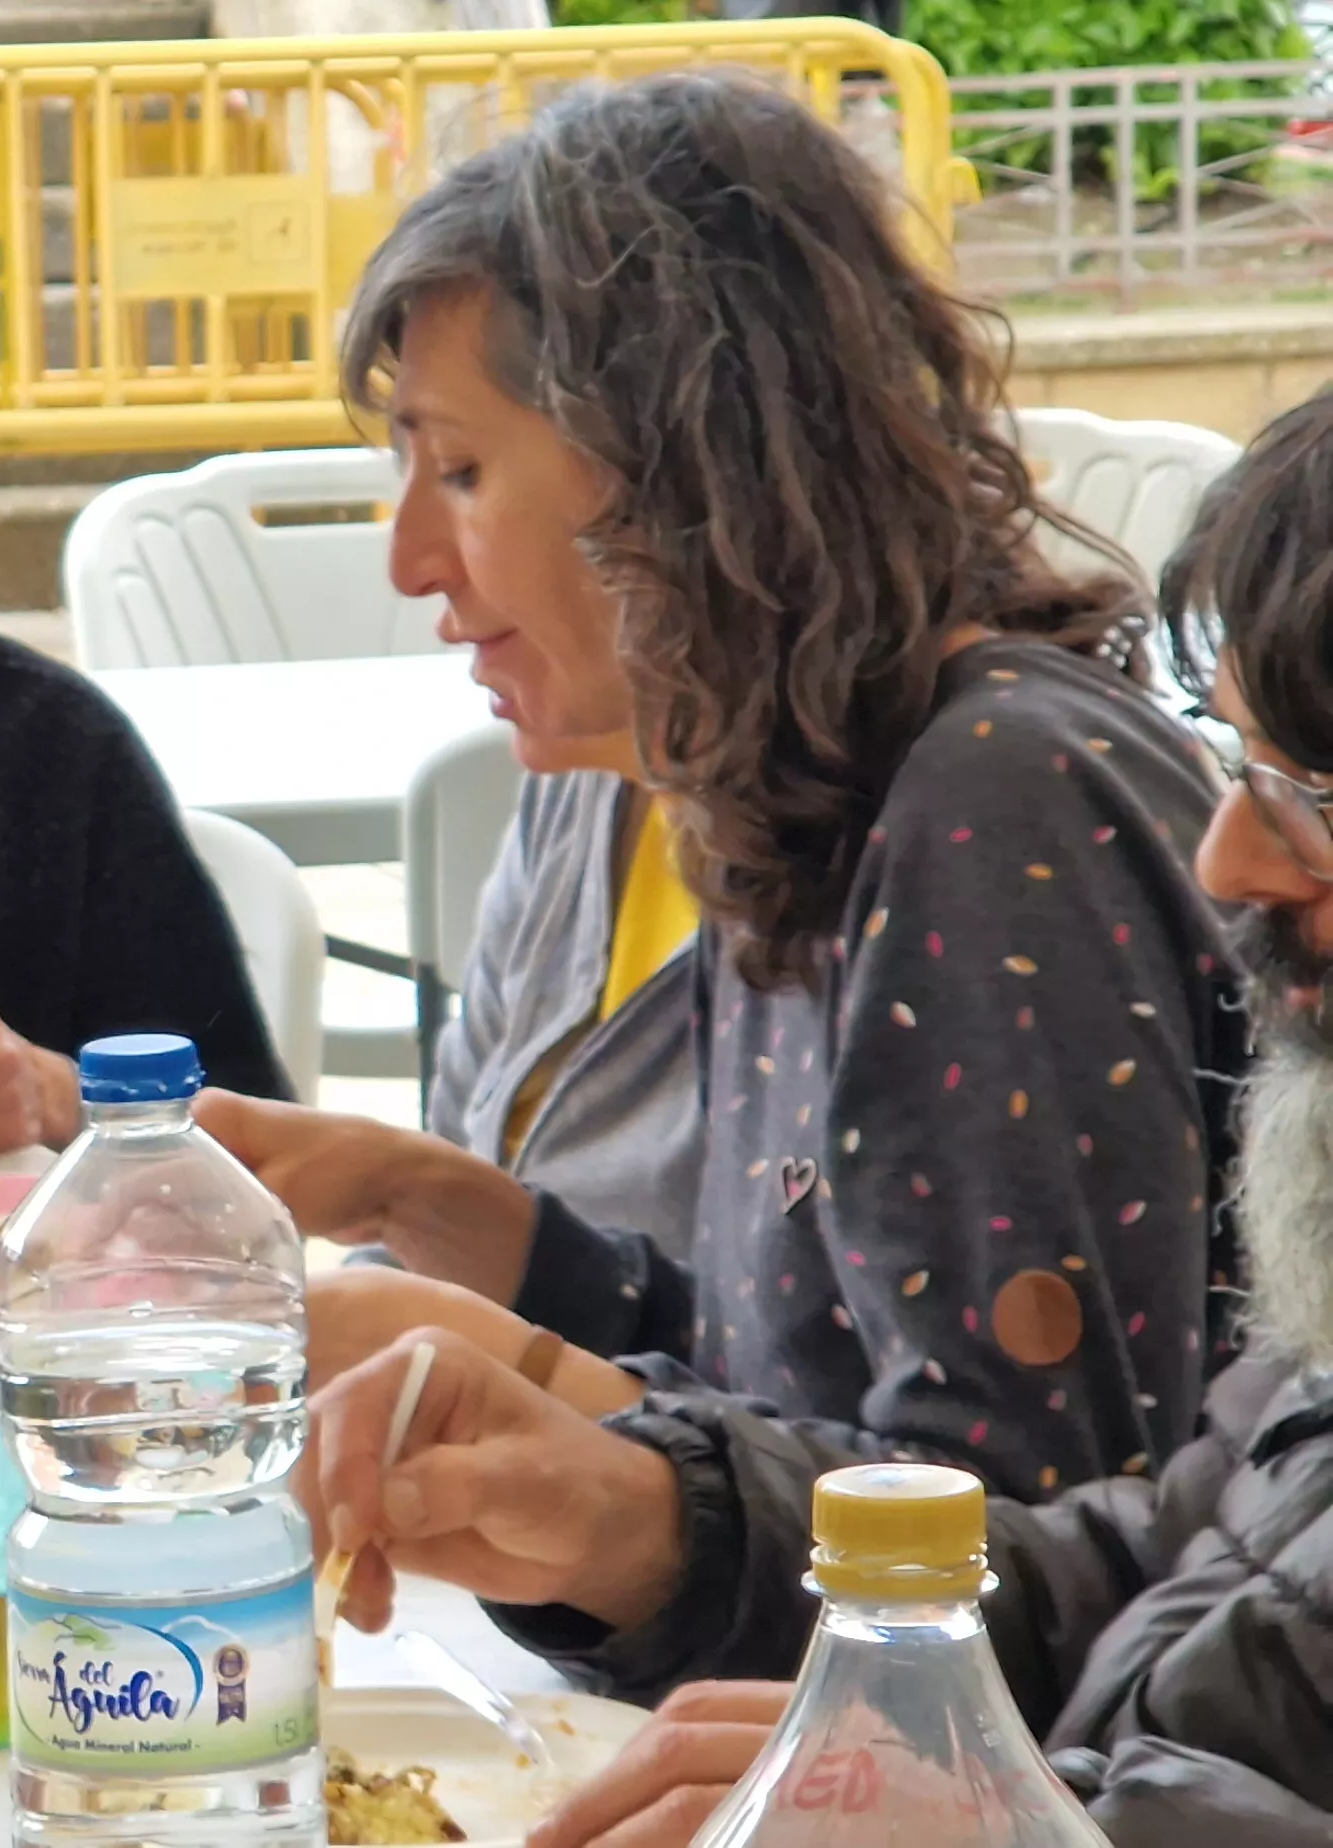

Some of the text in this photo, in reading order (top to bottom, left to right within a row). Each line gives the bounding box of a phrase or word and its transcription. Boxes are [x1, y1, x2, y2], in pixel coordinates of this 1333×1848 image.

[79, 1661, 114, 1686] del
[48, 1651, 180, 1734] Águila
[52, 1734, 192, 1753] Agua Mineral Natural
